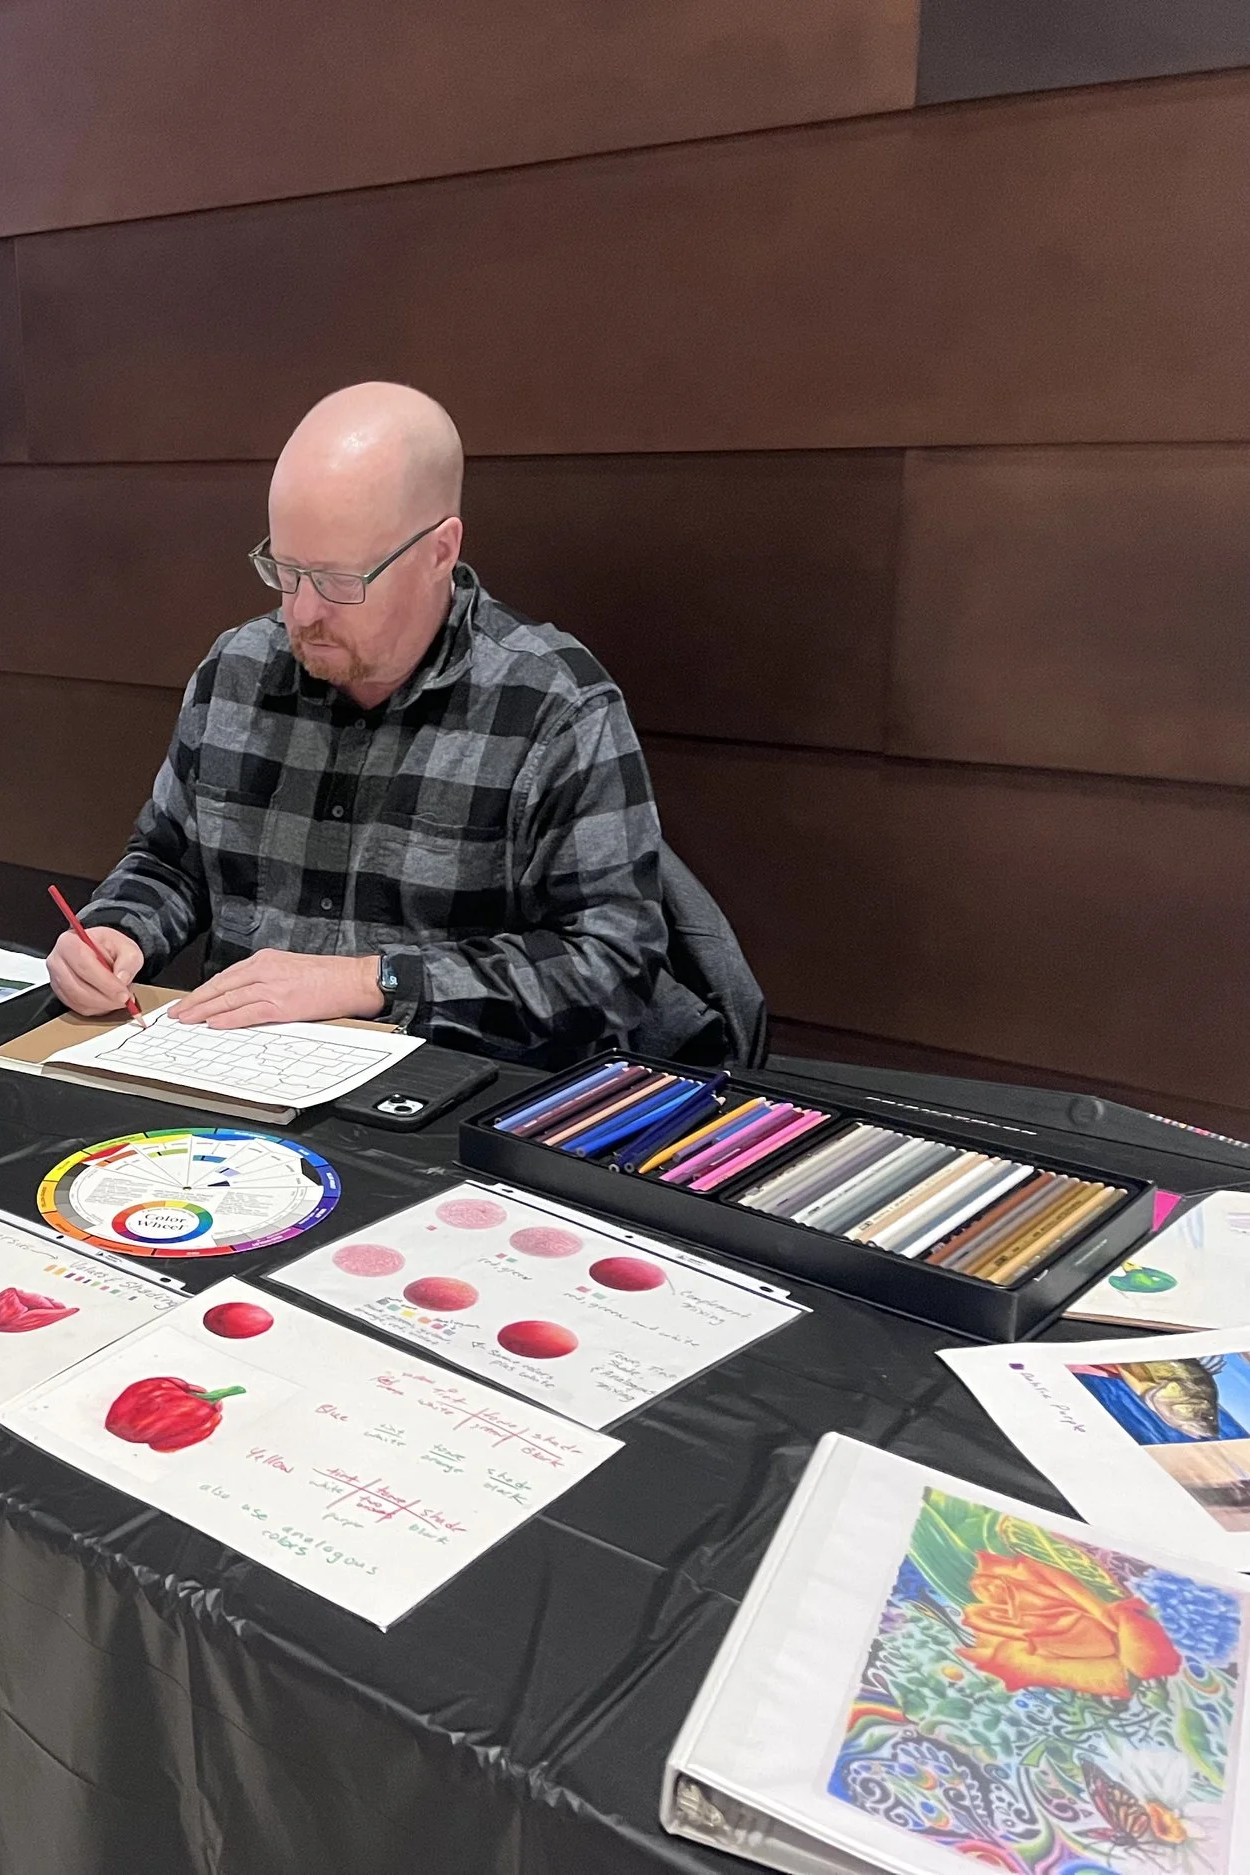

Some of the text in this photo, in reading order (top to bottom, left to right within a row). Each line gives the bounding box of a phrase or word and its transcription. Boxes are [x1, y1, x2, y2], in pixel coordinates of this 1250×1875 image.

[138, 1220, 183, 1231] Wheel
[145, 1213, 187, 1223] Color
[314, 1403, 350, 1422] Blue
[198, 1482, 268, 1523] also use
[260, 1528, 308, 1557] colors
[281, 1524, 381, 1577] analogous
